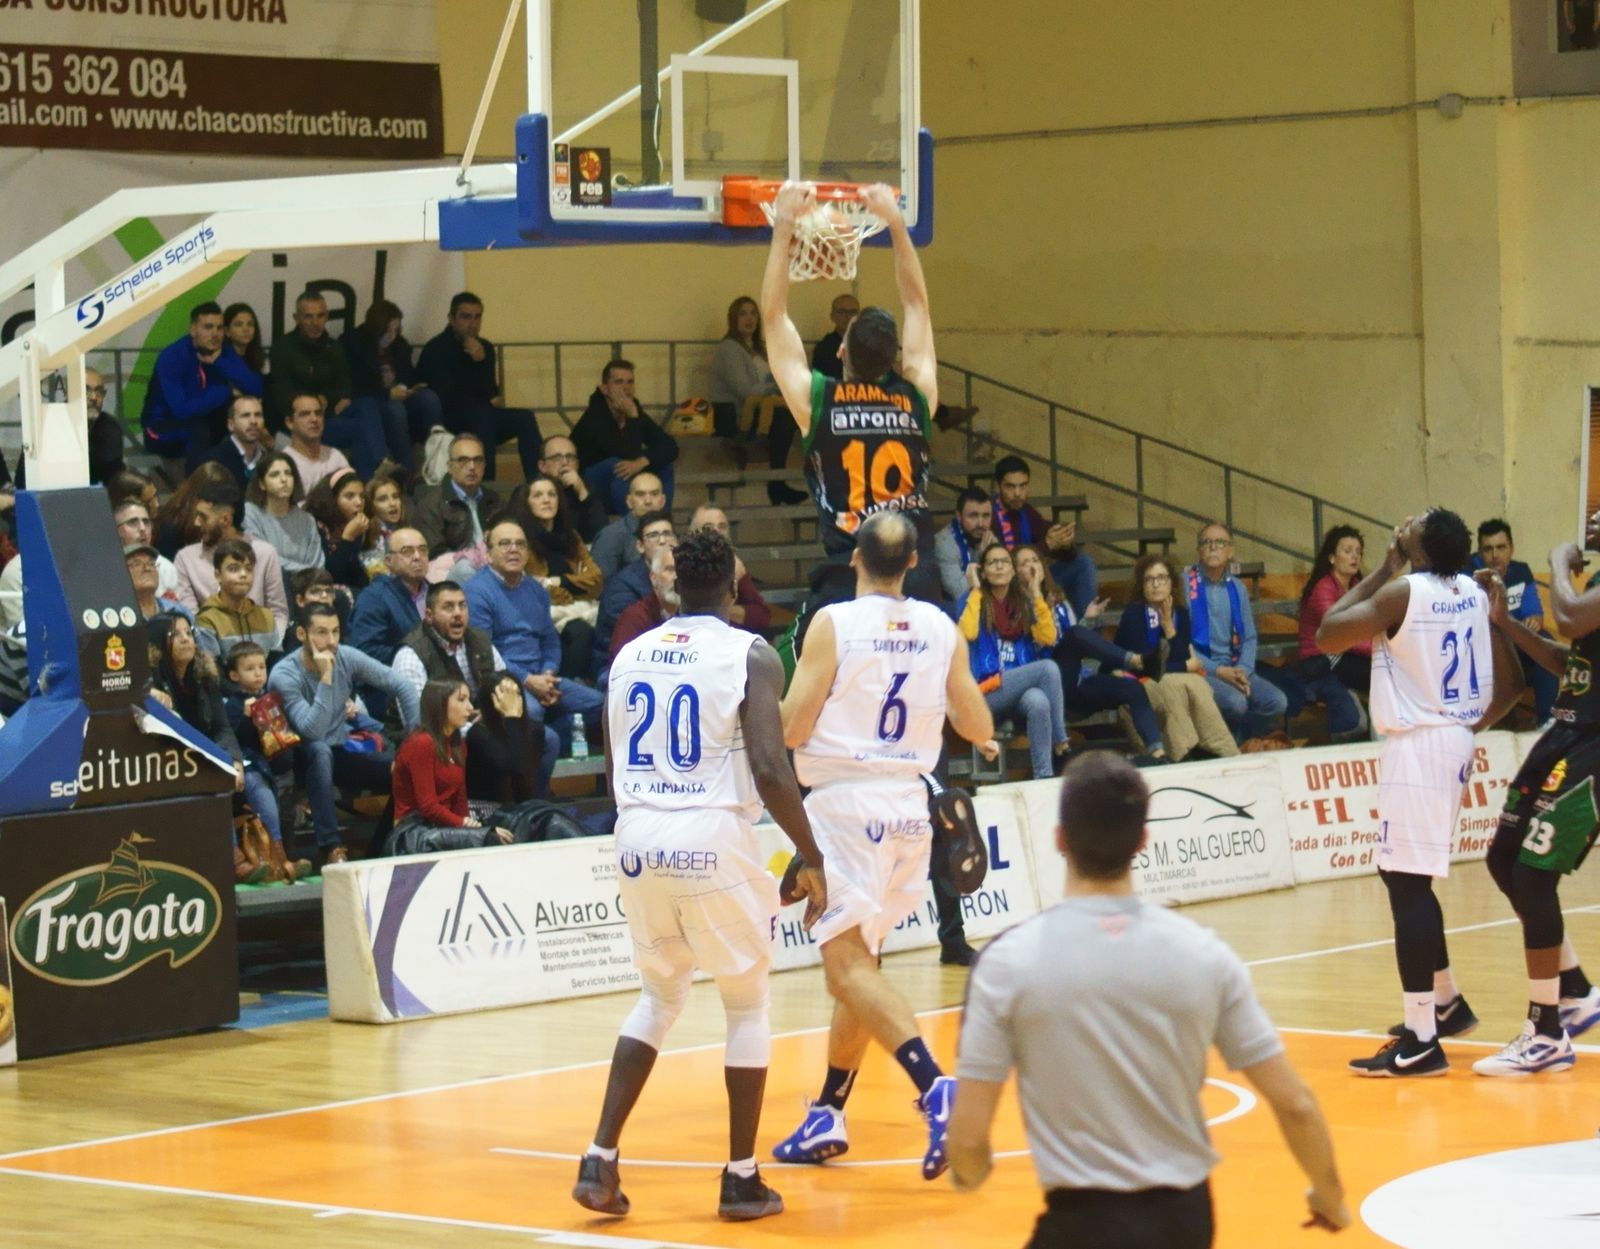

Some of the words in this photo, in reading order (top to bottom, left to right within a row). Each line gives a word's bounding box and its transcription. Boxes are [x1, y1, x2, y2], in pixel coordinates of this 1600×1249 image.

[63, 53, 120, 96] 362
[128, 56, 187, 99] 084
[110, 106, 428, 140] www.chaconstructiva.com
[104, 260, 163, 304] Schelde
[164, 226, 215, 265] Sports
[841, 440, 914, 512] 10
[651, 649, 699, 665] DIENG
[1440, 626, 1480, 704] 21
[878, 672, 911, 743] 6
[625, 681, 702, 773] 20
[78, 748, 199, 793] eitunas
[1176, 828, 1267, 865] SALGUERO
[1522, 816, 1556, 855] 23
[646, 850, 719, 871] UMBER
[1144, 867, 1197, 883] MULTIMARCAS
[1330, 852, 1356, 868] Con
[1360, 847, 1374, 865] el
[25, 881, 206, 963] Fragata
[535, 901, 609, 928] Alvaro
[926, 887, 1009, 925] MRON
[540, 951, 569, 960] Montaje
[572, 949, 581, 957] de
[582, 945, 612, 956] antenas
[542, 959, 597, 972] Mantenimiento
[599, 957, 608, 966] de
[571, 977, 607, 989] Servicio
